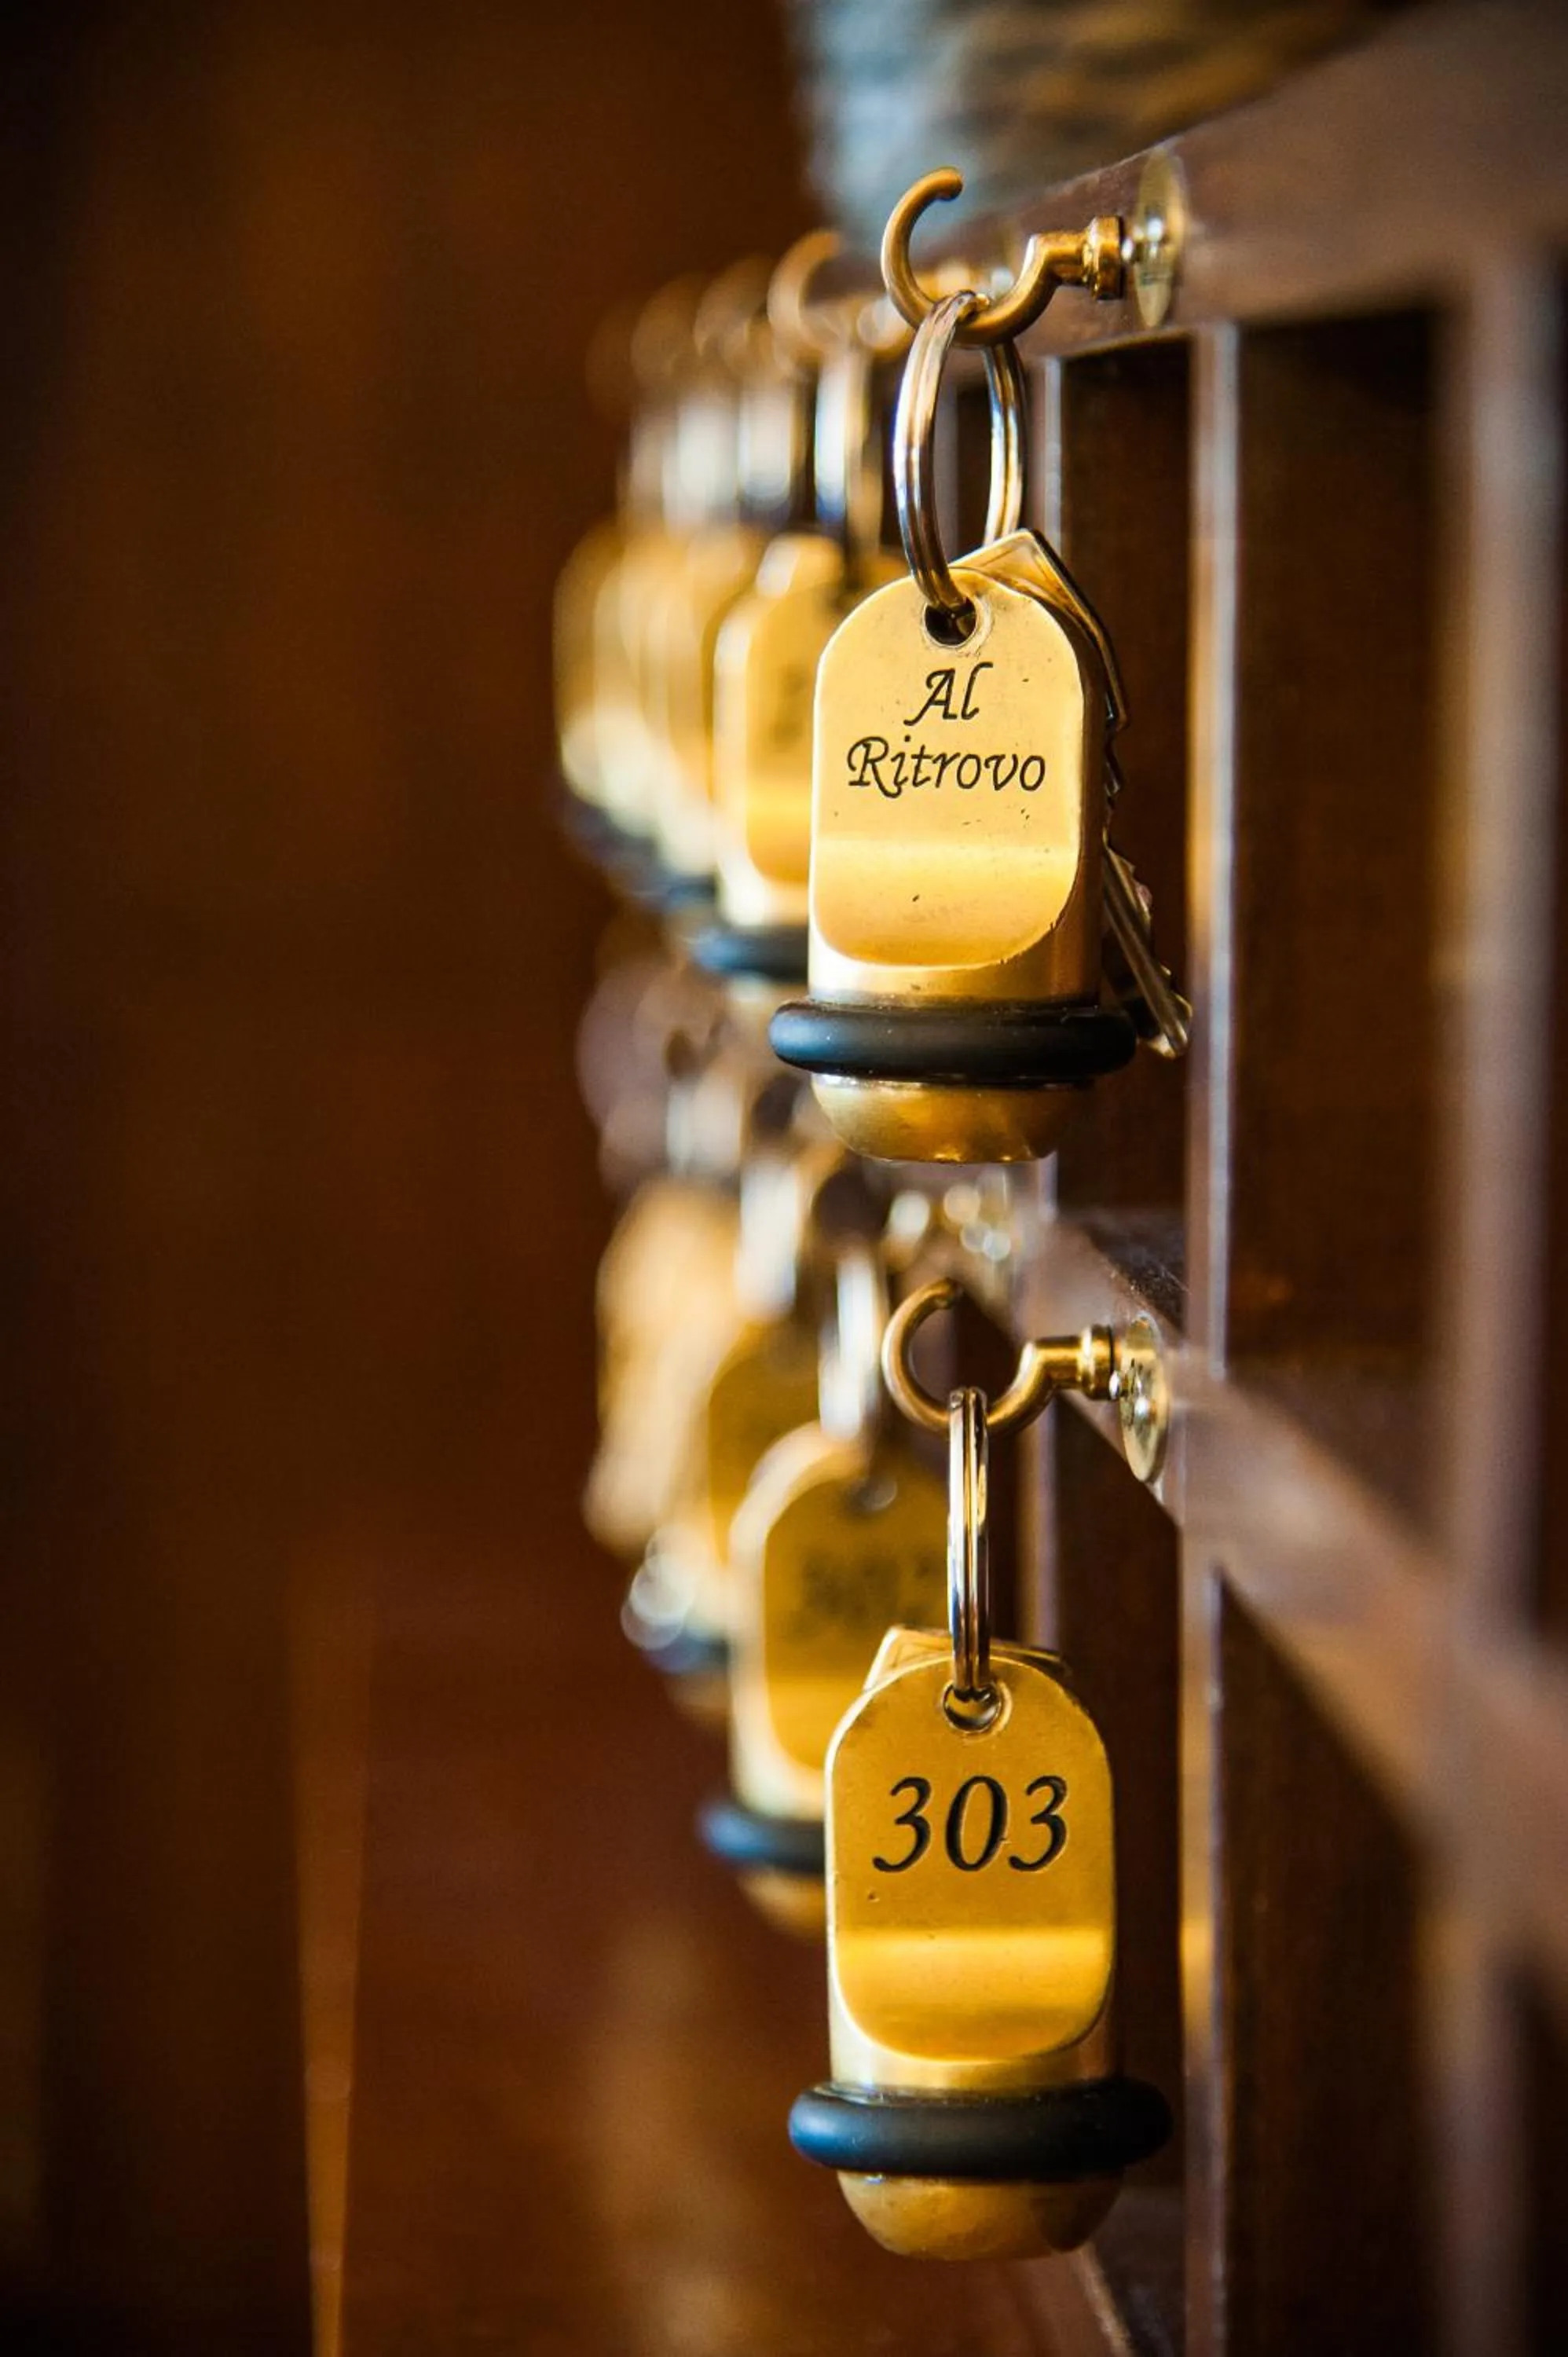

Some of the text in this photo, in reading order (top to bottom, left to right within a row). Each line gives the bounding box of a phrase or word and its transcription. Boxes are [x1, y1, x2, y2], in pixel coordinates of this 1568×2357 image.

[903, 662, 994, 727] Al
[846, 734, 1046, 799] Ritrovo
[872, 1775, 1068, 1873] 303
